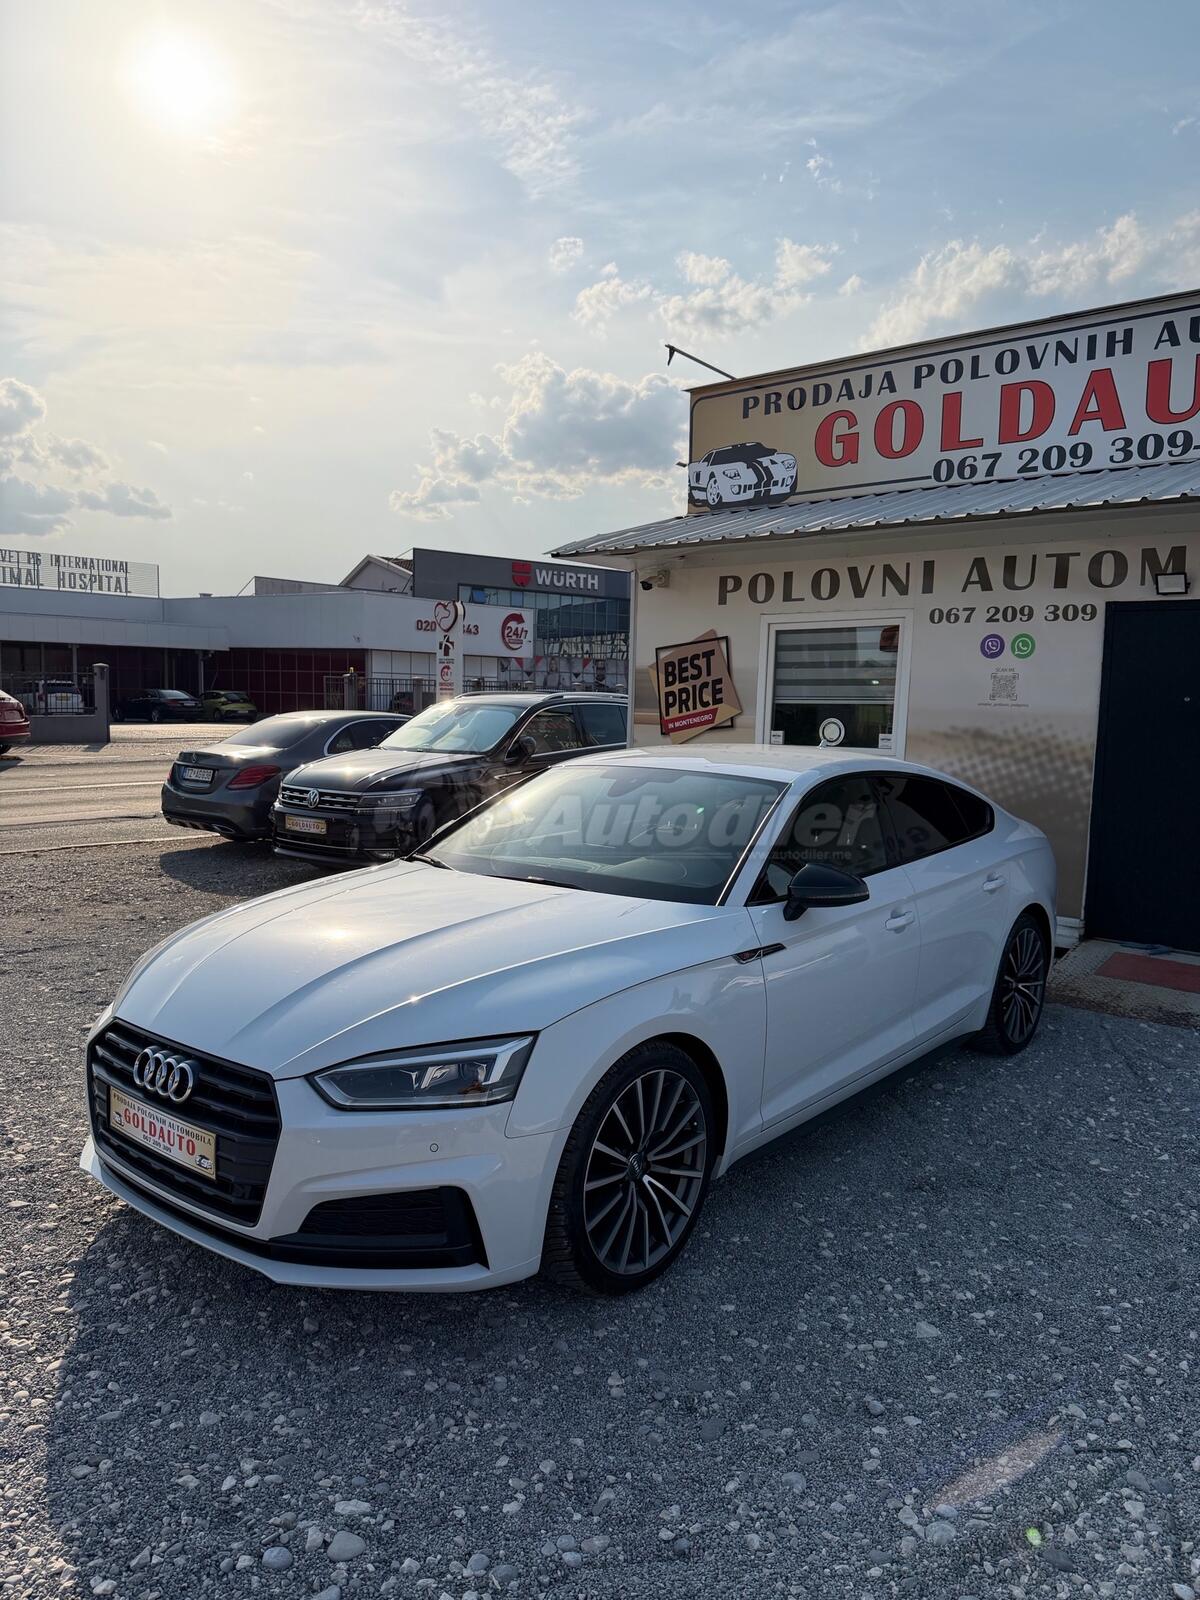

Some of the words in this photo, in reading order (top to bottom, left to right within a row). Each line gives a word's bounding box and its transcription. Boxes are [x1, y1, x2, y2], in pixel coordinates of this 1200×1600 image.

[742, 370, 897, 419] PRODAJA
[914, 328, 1133, 389] POLOVNIH
[814, 353, 1200, 467] GOLDAU
[933, 452, 1002, 482] 067
[1017, 442, 1093, 474] 209
[1109, 430, 1194, 464] 309
[50, 554, 131, 573] INTERNATIONAL
[718, 560, 935, 605] POLOVNI
[961, 545, 1187, 592] AUTOM
[58, 571, 131, 593] HOSPITAL
[535, 568, 599, 590] WÜRTH
[416, 619, 437, 632] 020
[929, 607, 976, 624] 067
[985, 605, 1034, 623] 209
[1044, 603, 1098, 622] 309
[506, 626, 528, 639] 24/7
[664, 649, 716, 688] BEST
[664, 678, 724, 717] PRICE
[674, 714, 713, 728] MONTENEGRO
[124, 1108, 196, 1156] GOLDAUTO
[168, 1121, 212, 1146] AUTOMOBILA
